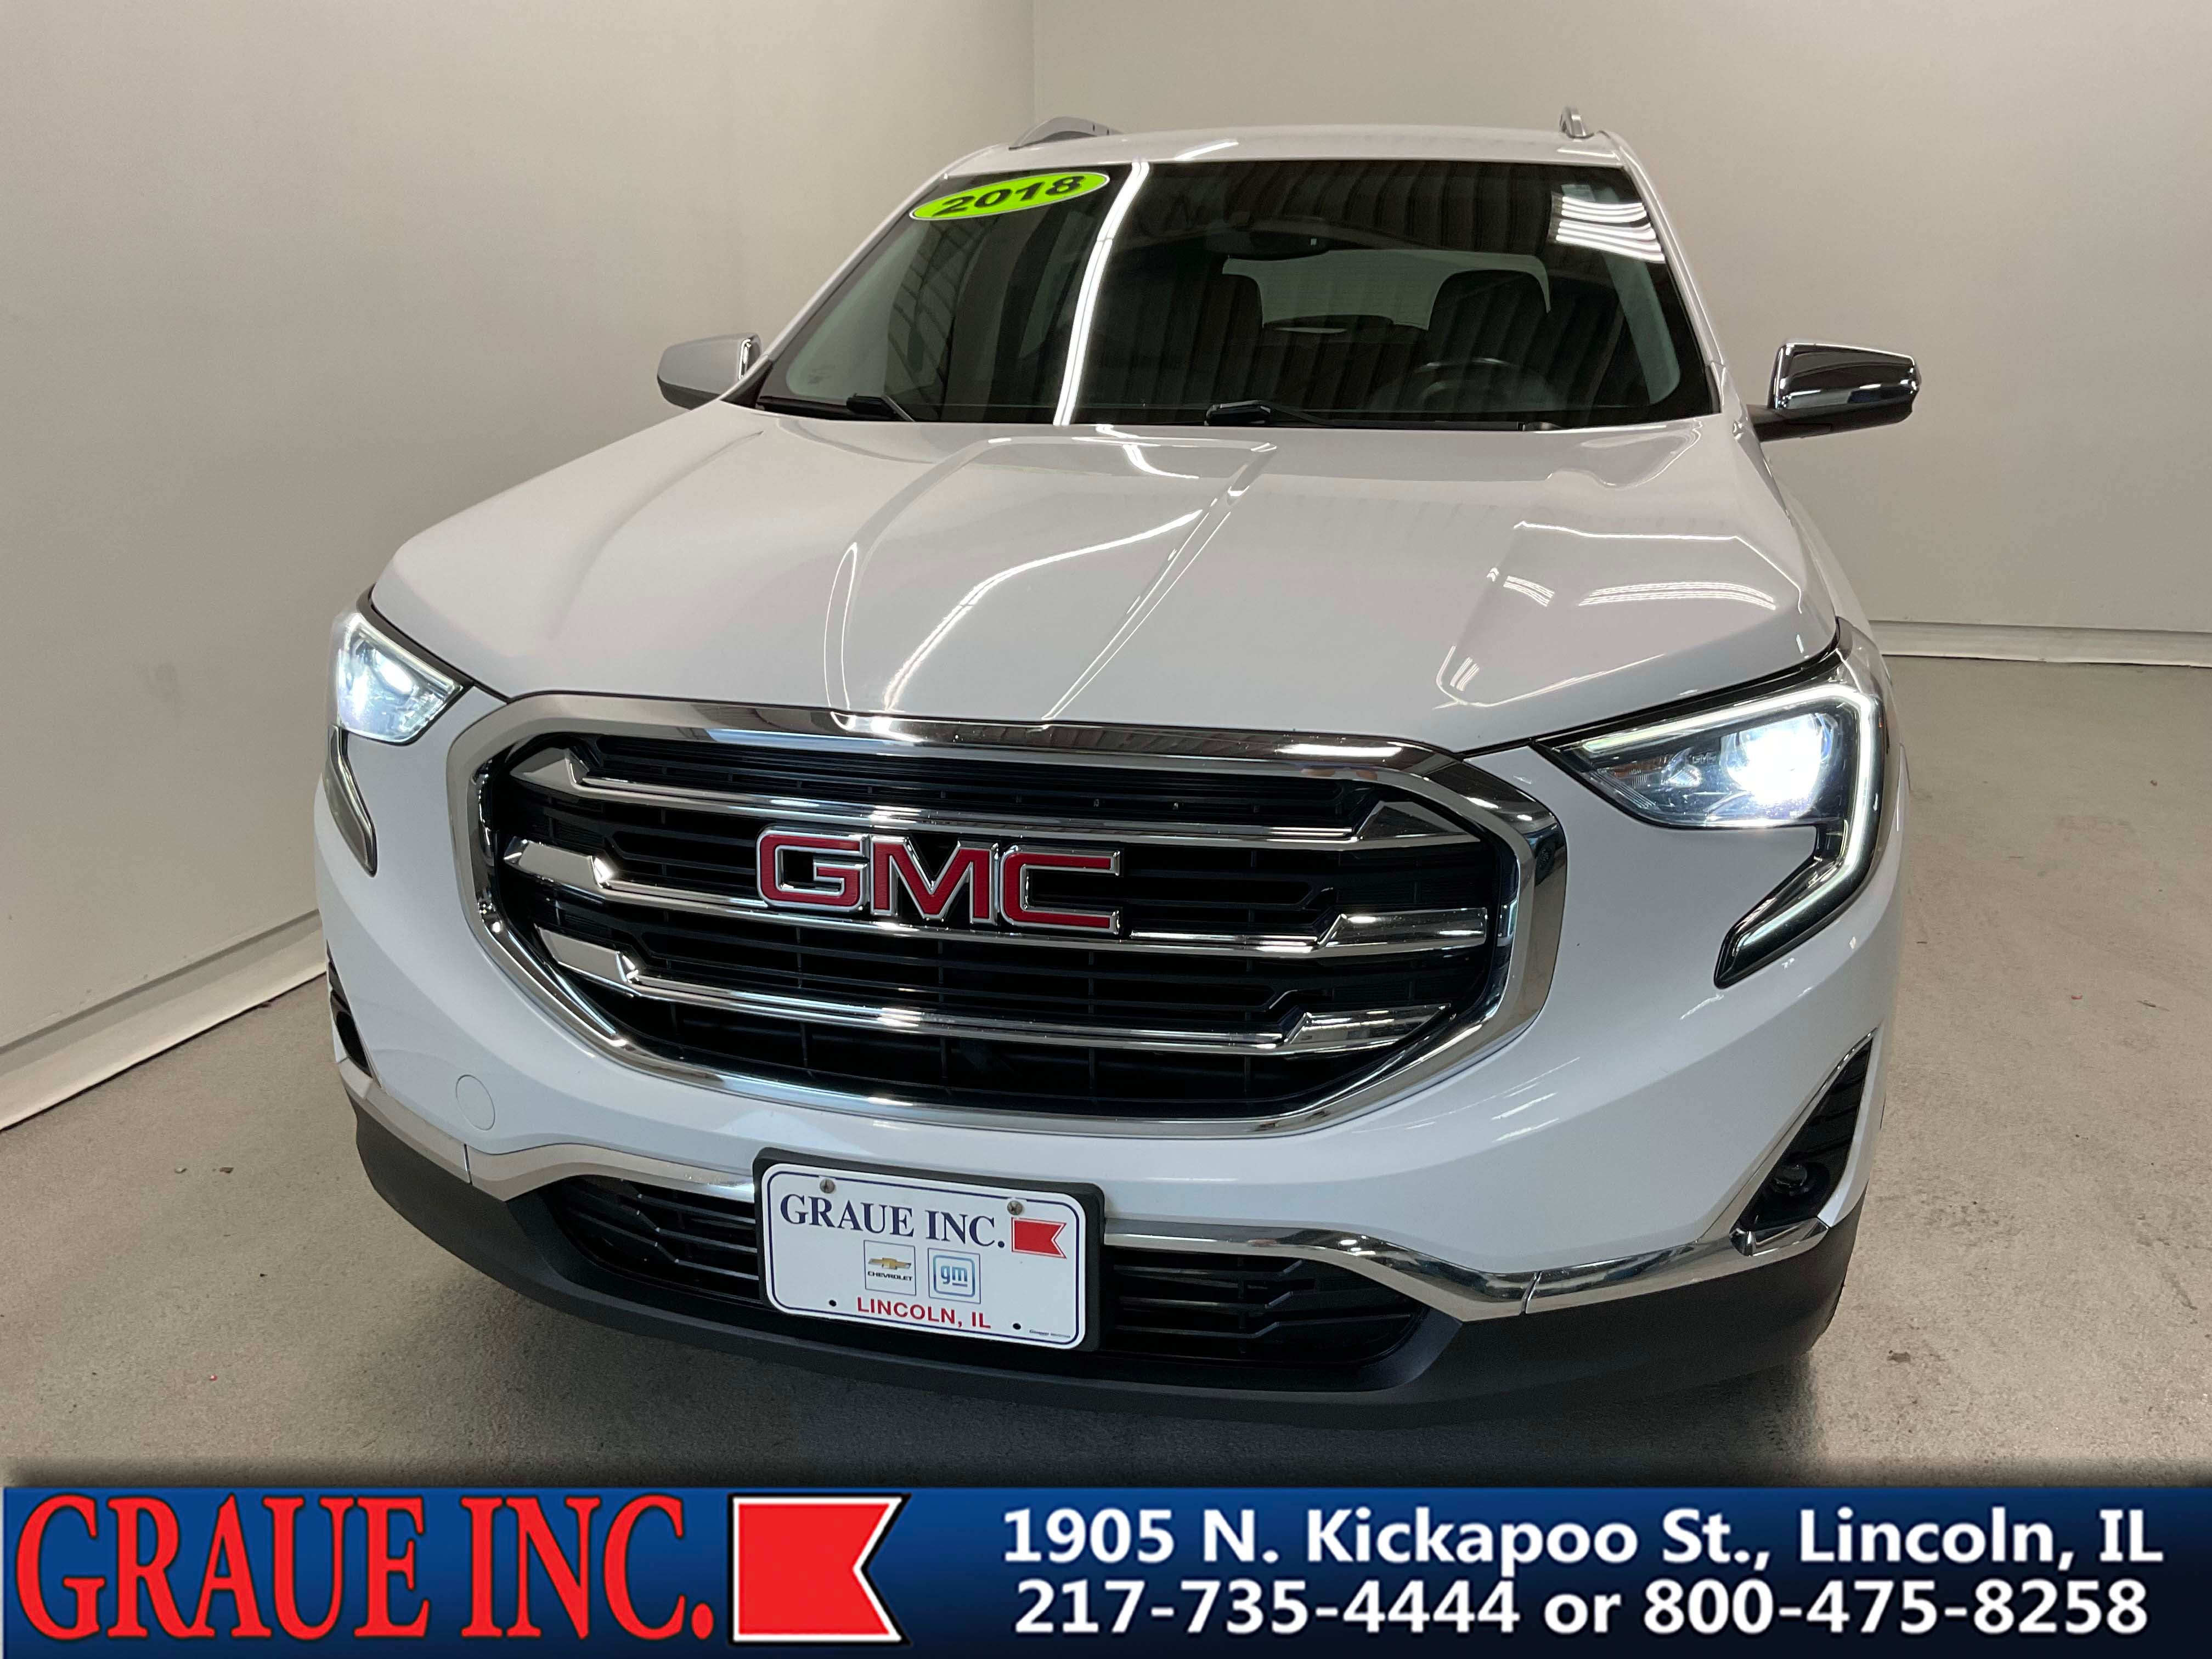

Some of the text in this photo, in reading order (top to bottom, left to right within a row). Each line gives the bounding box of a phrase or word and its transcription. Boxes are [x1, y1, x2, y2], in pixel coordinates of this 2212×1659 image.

[932, 175, 1085, 217] 2018
[757, 826, 1121, 935] GMC
[780, 1193, 1006, 1249] GRAUE INC.
[867, 1270, 913, 1282] CHEVROLET
[857, 1297, 991, 1329] LINCOLN, IL
